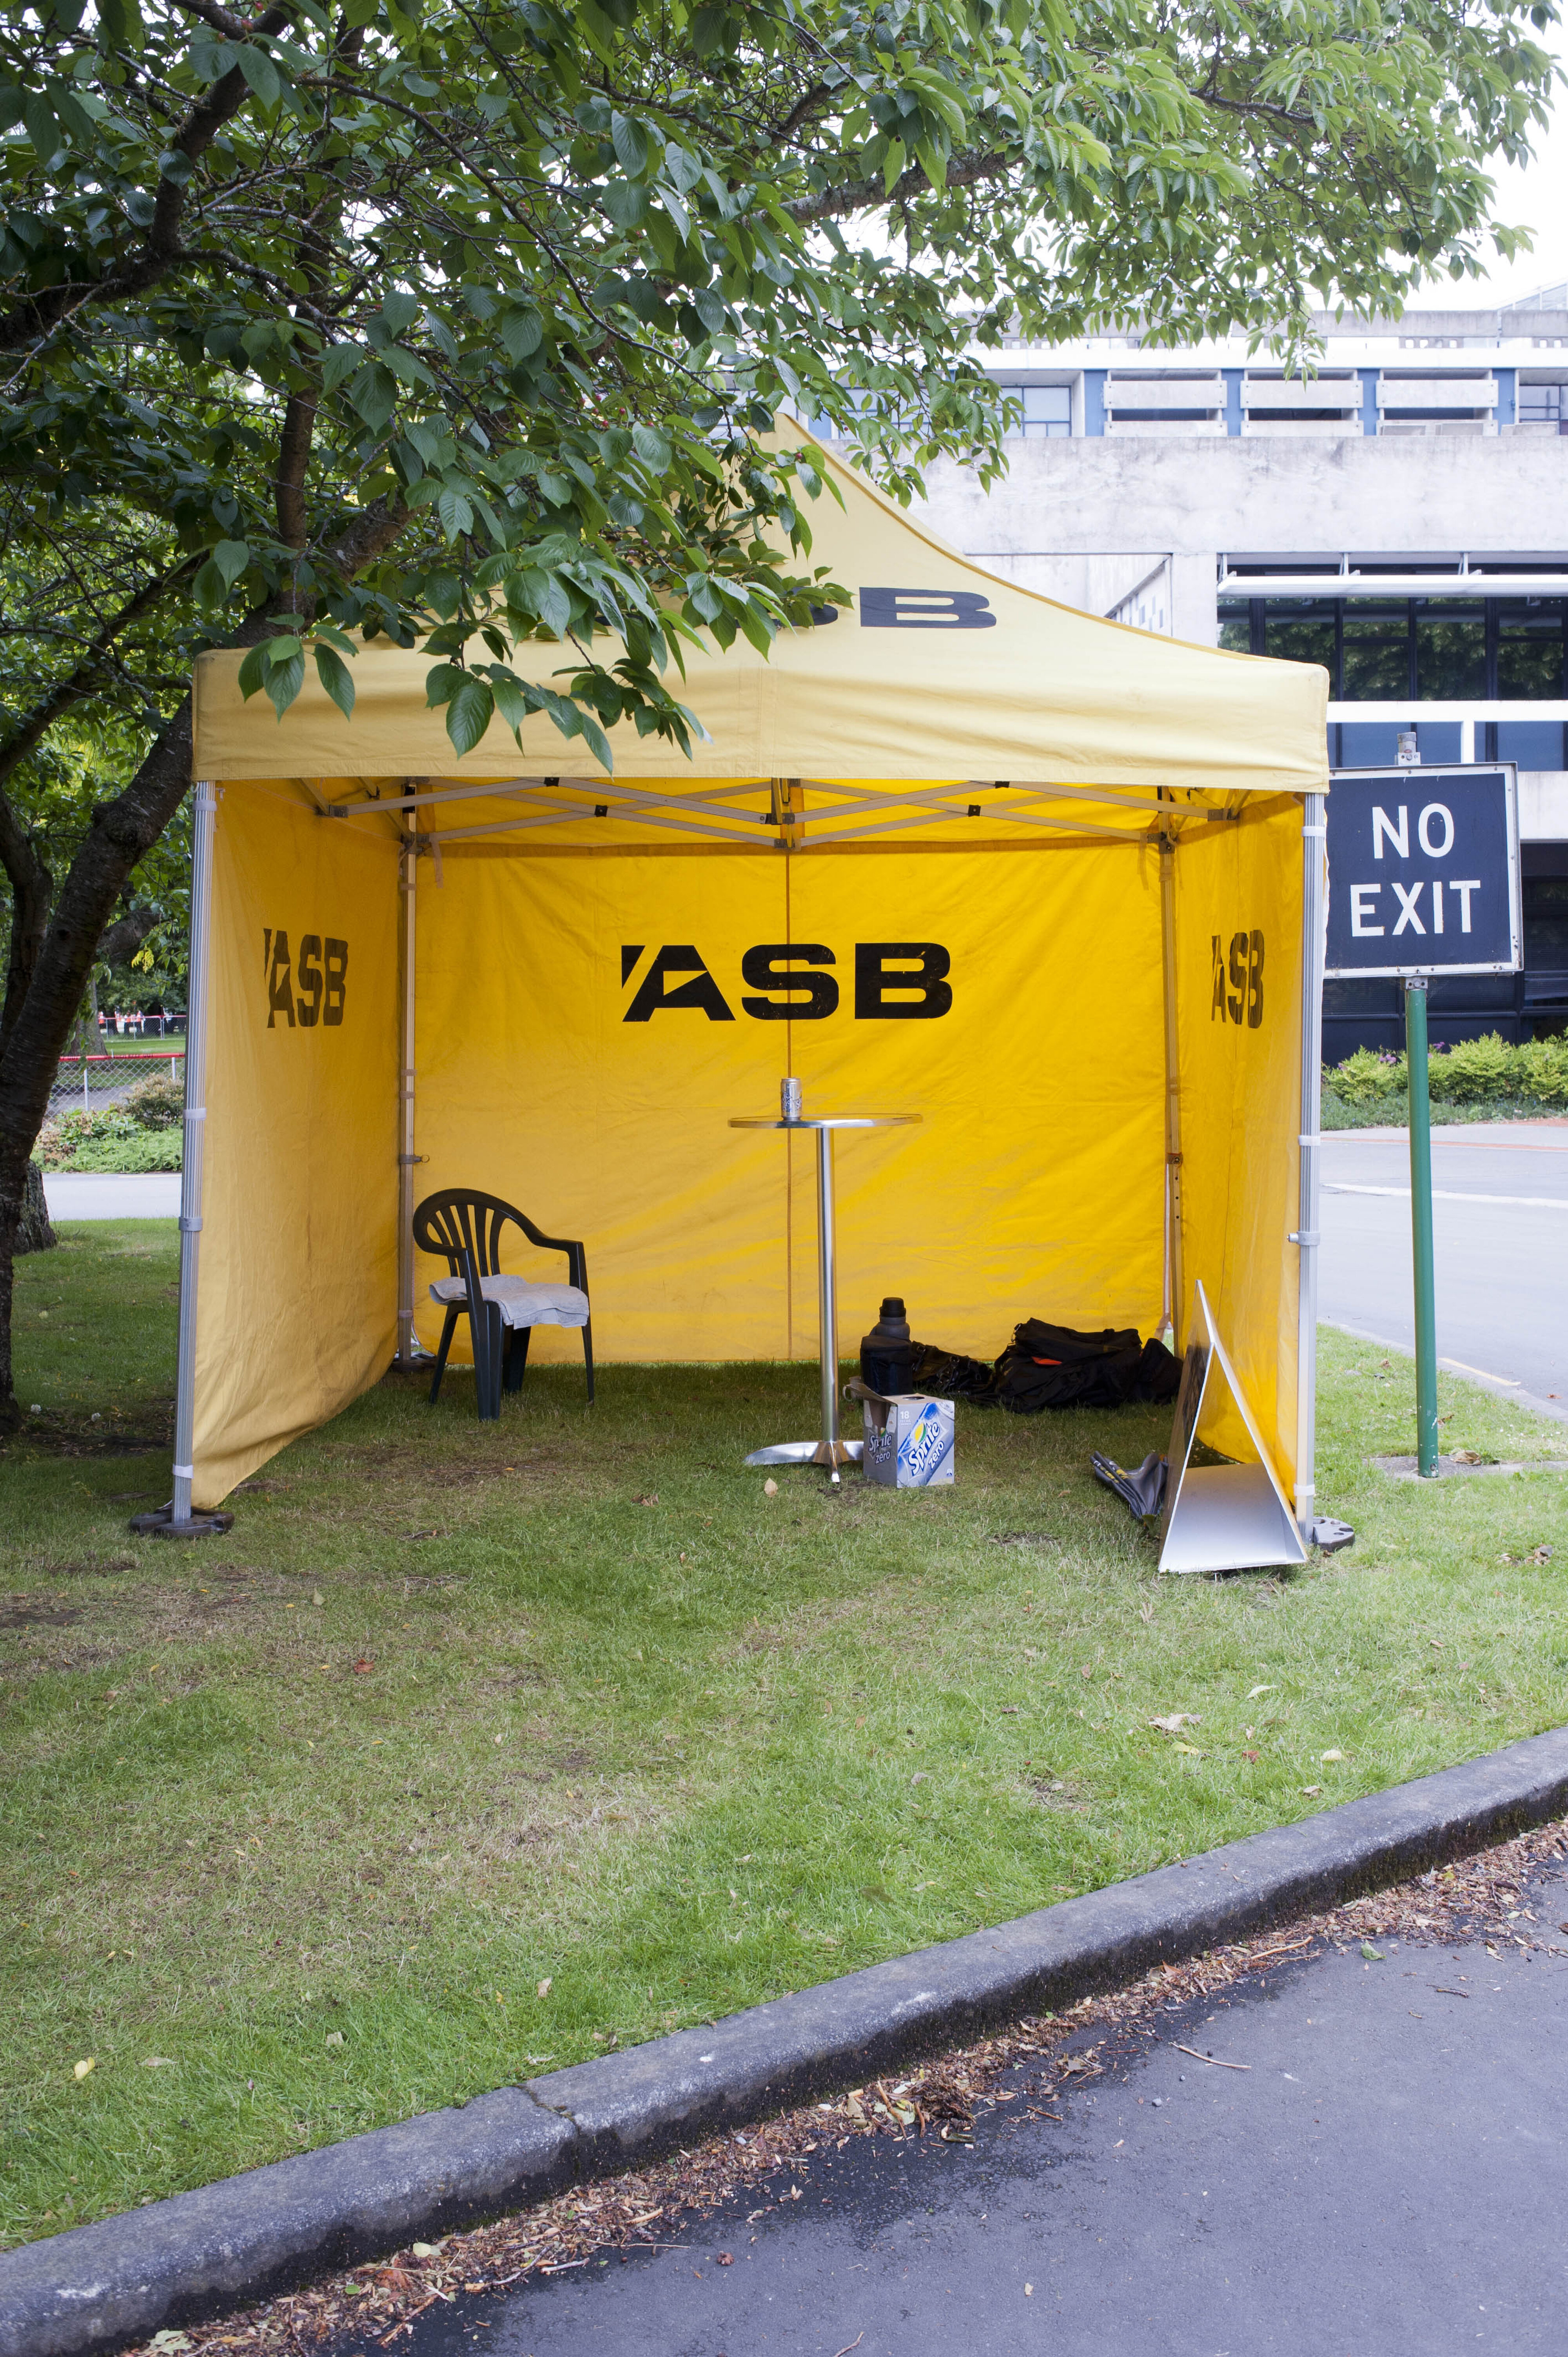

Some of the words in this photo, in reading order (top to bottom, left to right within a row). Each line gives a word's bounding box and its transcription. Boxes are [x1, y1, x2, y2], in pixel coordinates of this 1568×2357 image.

[1372, 803, 1454, 859] NO
[1350, 880, 1481, 937] EXIT
[263, 928, 348, 1028] ASB
[621, 942, 953, 1022] ASB
[1211, 929, 1265, 1029] ASB
[900, 1410, 909, 1419] 18
[868, 1433, 892, 1453] Spite
[875, 1451, 891, 1465] zero
[908, 1422, 940, 1476] Sprite
[928, 1441, 945, 1470] zero
